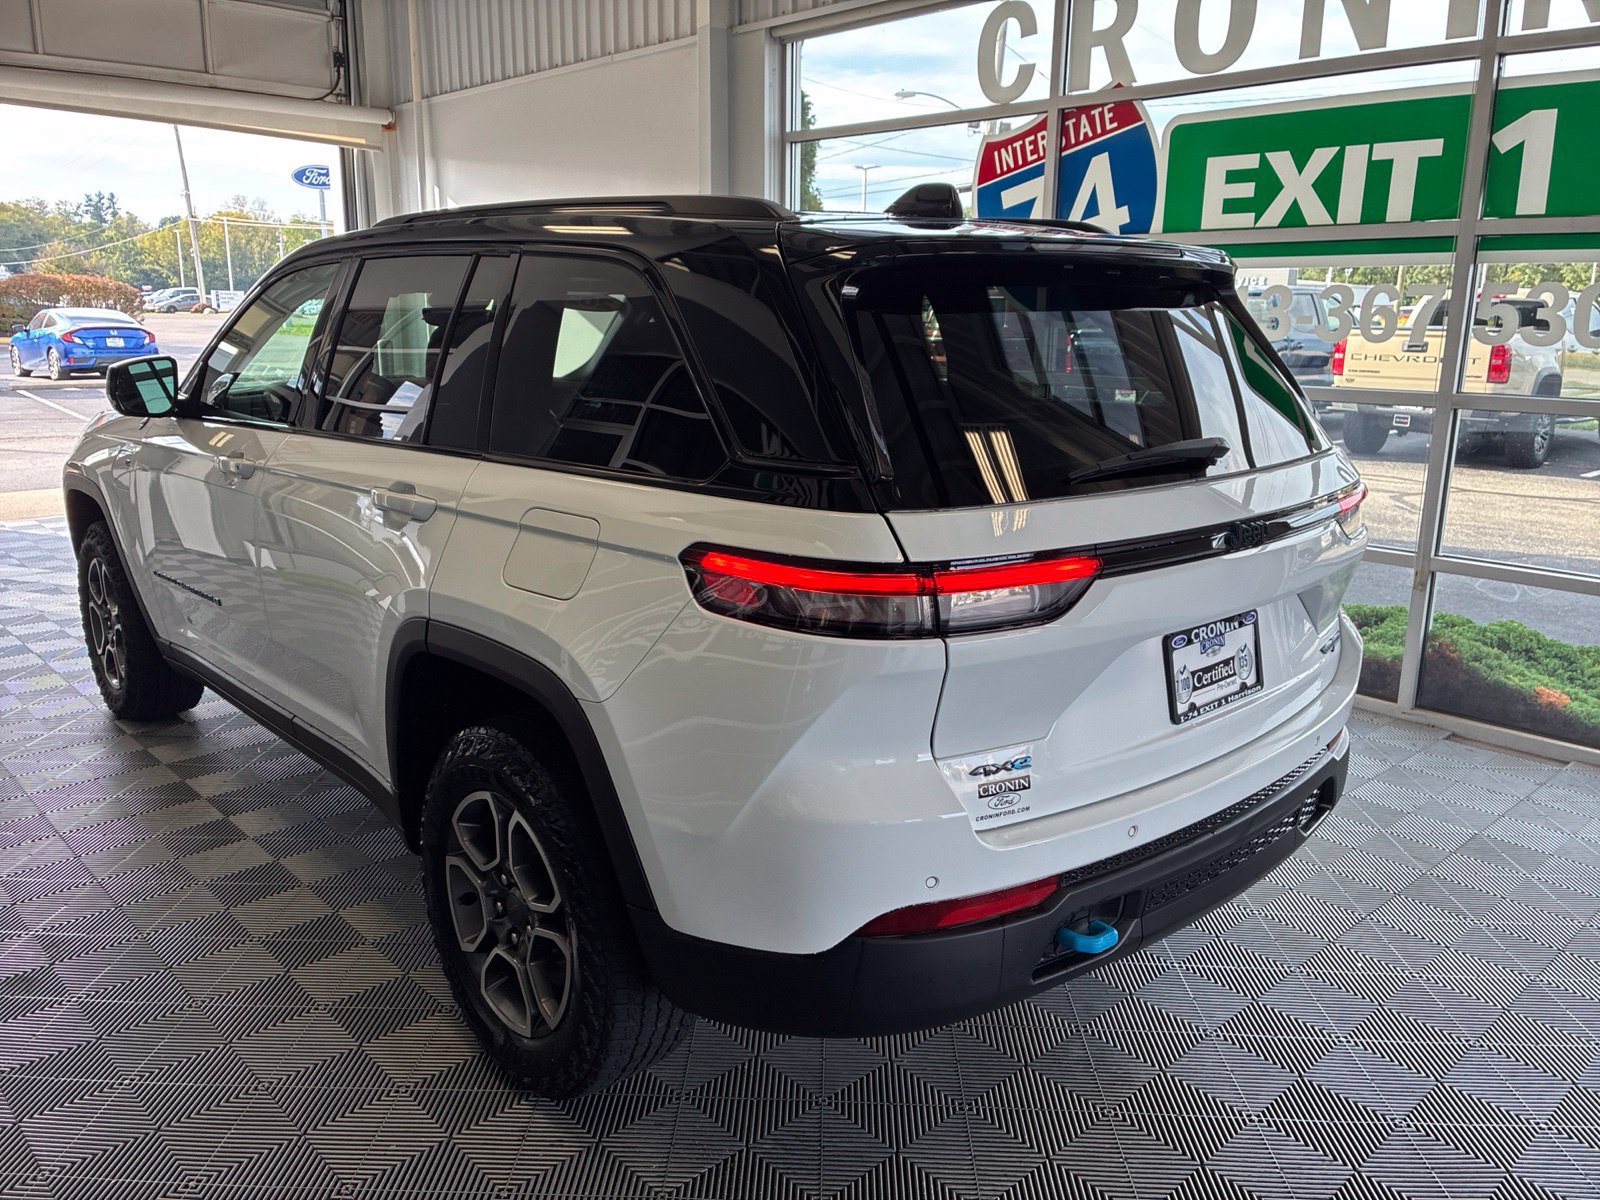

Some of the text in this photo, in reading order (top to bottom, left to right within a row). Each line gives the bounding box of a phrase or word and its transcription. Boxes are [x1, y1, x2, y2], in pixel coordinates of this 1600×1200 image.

[978, 0, 1600, 103] CRON
[994, 103, 1118, 174] INTERTATE
[1201, 108, 1557, 229] EXIT 1
[1351, 352, 1482, 365] CHEVROT
[1191, 621, 1239, 643] CRONIN
[1200, 636, 1225, 652] CRONIN
[1194, 660, 1234, 687] Certified
[1180, 685, 1261, 723] I-74 EXIT 1 Harrison
[979, 778, 1030, 796] CRONIN
[994, 795, 1015, 807] Ford
[975, 806, 1030, 822] CRONINFORD.COM
